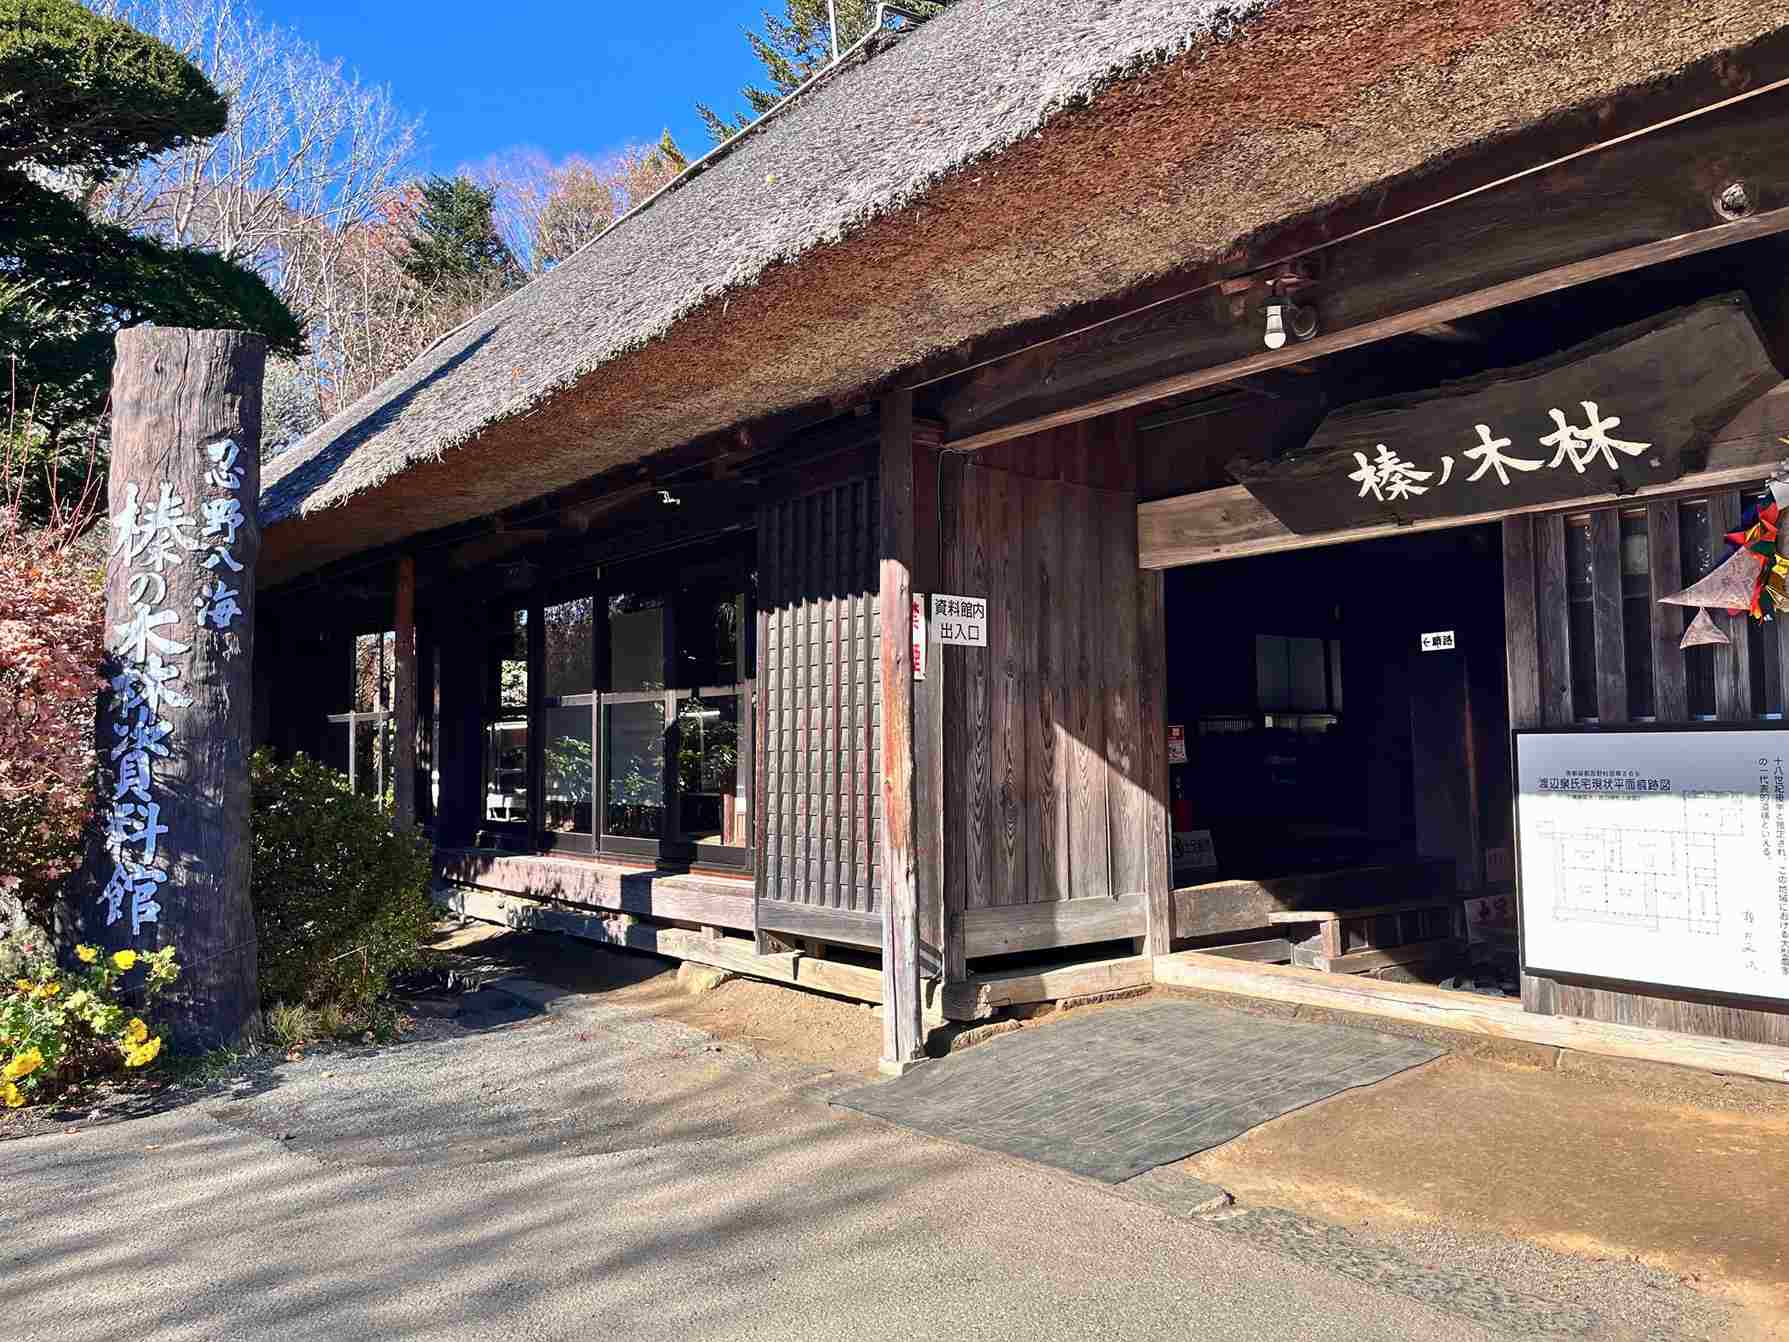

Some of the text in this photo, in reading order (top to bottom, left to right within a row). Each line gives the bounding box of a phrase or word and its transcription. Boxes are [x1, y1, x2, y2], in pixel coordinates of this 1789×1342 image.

[195, 438, 244, 630] 忍野八海
[935, 599, 984, 619] 資料館内
[941, 623, 979, 640] 出入口
